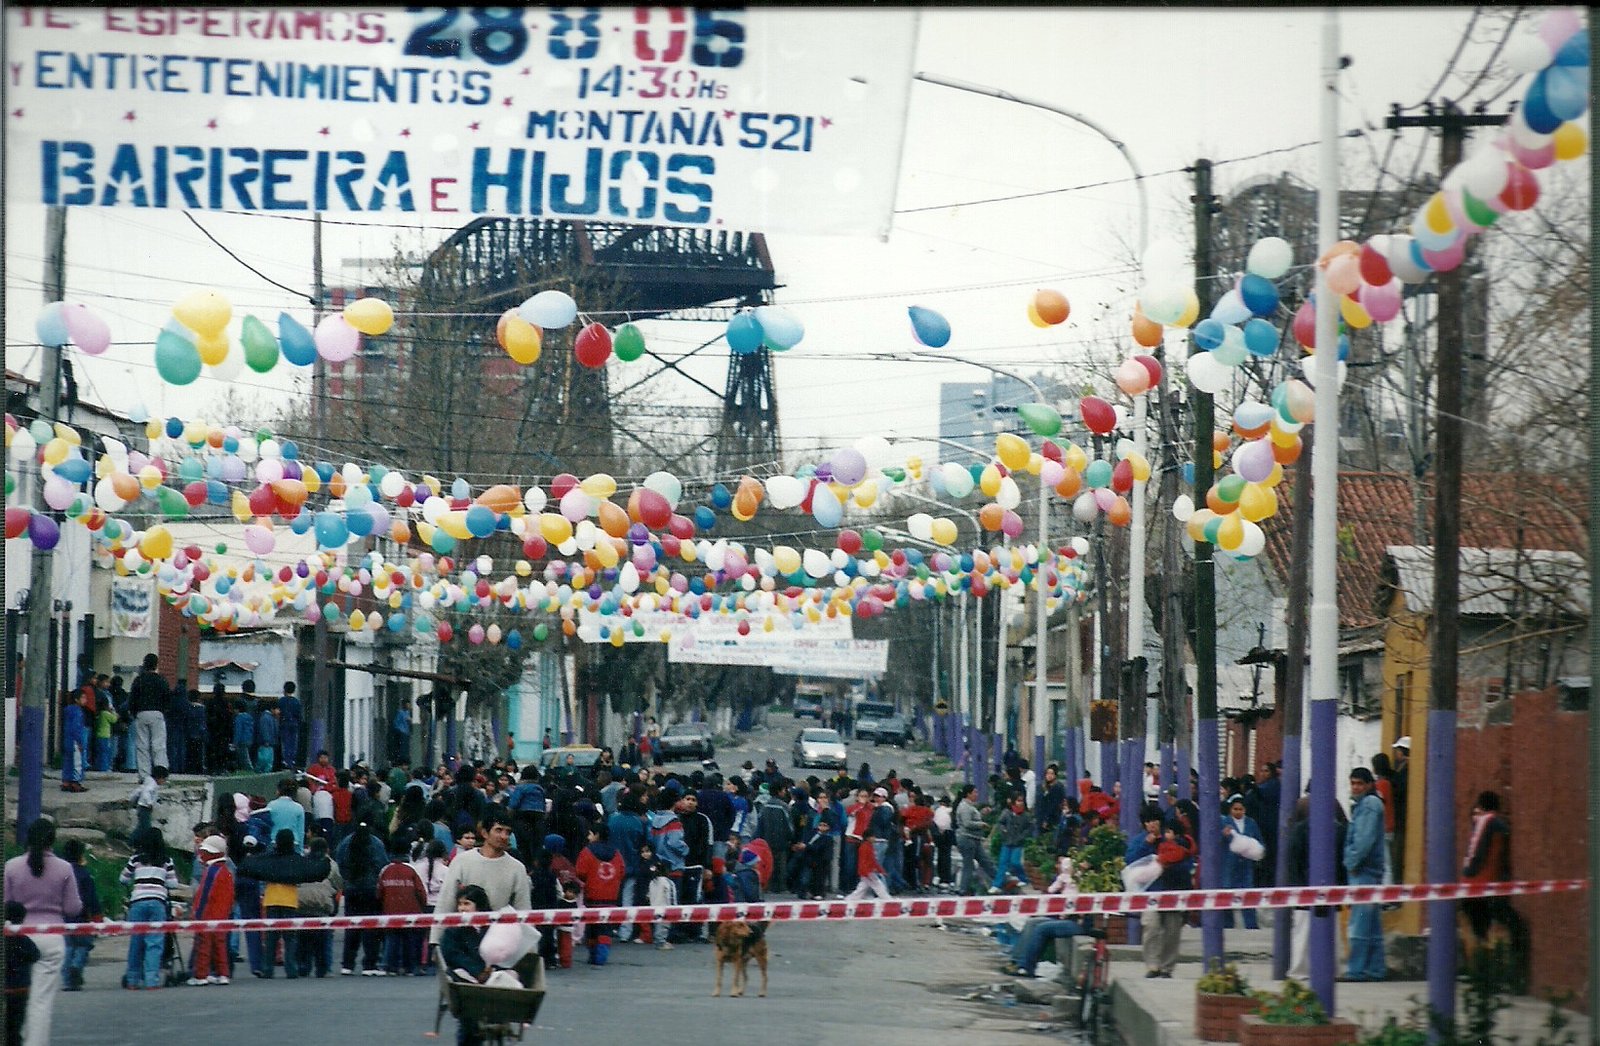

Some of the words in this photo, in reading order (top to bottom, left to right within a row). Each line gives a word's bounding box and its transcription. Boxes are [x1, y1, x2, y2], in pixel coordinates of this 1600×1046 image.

[10, 62, 22, 87] Y
[35, 50, 492, 105] ENTRETENIMIENTOS
[525, 106, 724, 147] MONTAÑA
[738, 112, 814, 152] 521
[41, 139, 416, 213] BARRERA
[430, 177, 459, 213] E
